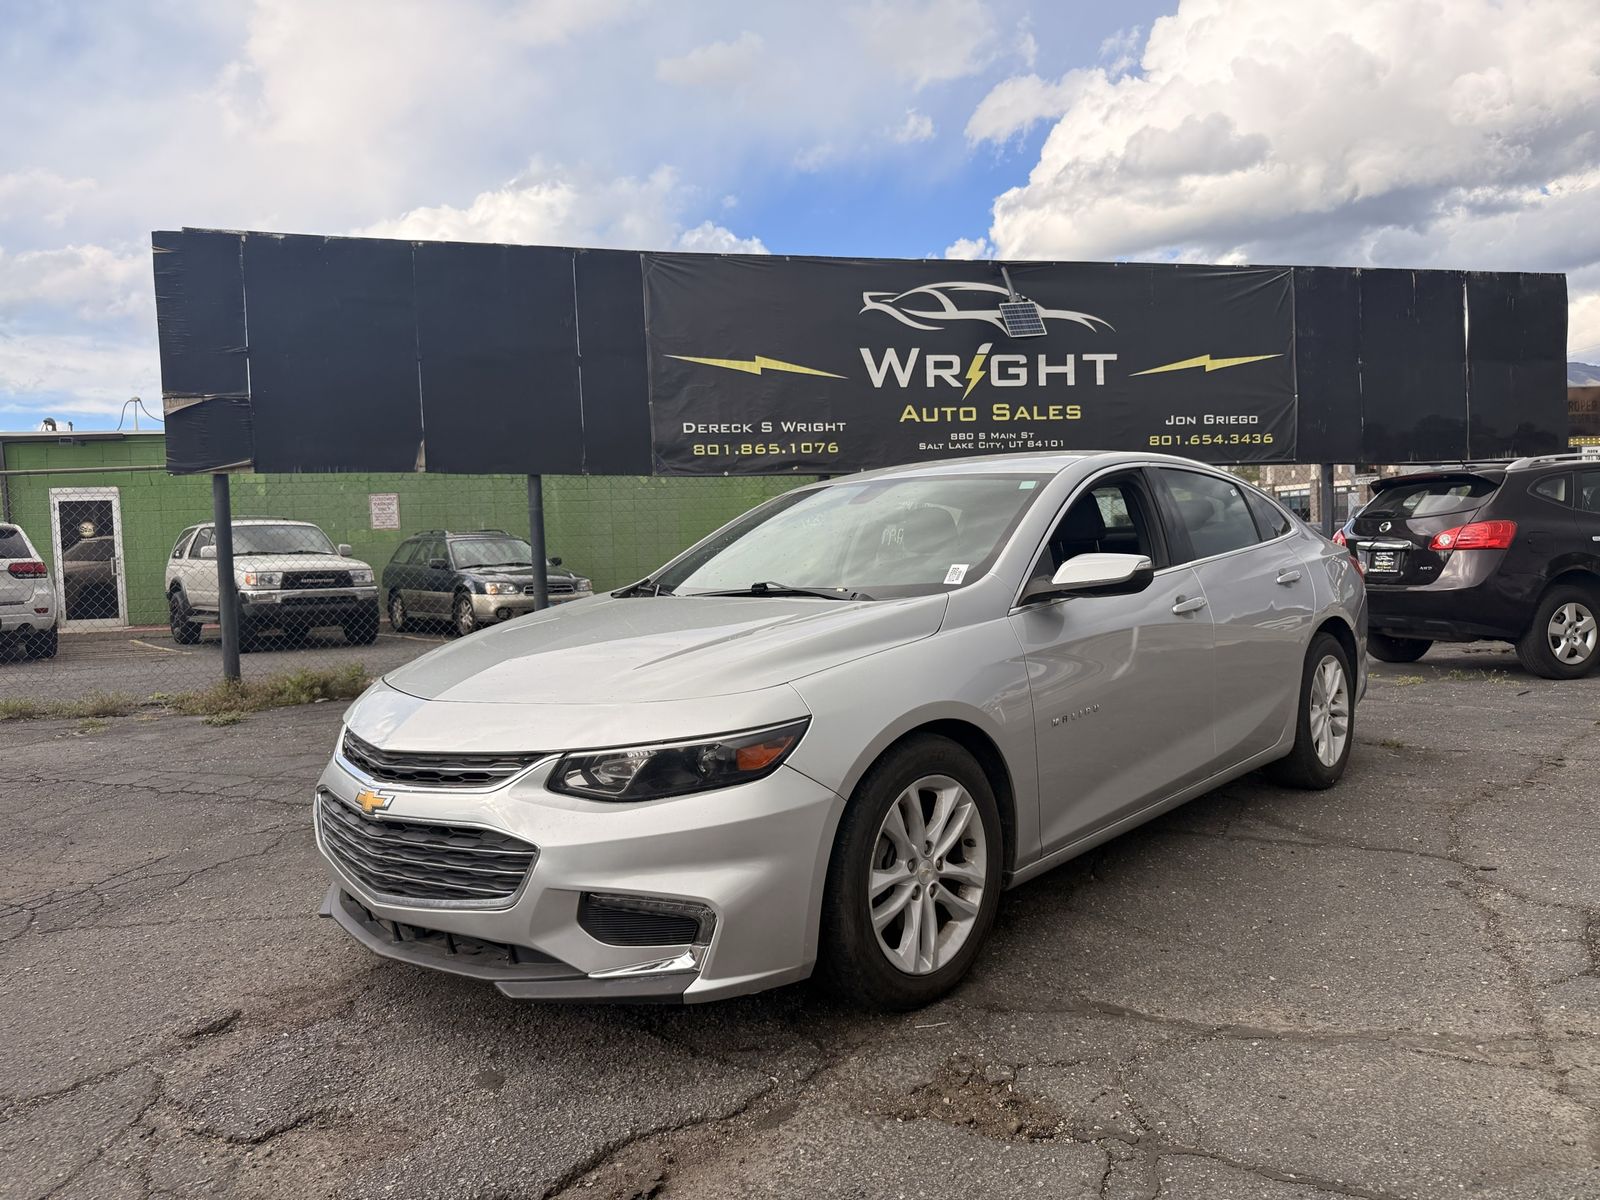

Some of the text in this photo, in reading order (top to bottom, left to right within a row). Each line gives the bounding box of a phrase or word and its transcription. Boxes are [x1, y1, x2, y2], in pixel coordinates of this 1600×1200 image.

[899, 403, 1082, 423] AUTO SALES
[1165, 414, 1259, 426] JON GRIEGO
[682, 421, 847, 434] DERECK S WRIGHT
[950, 432, 974, 441] 880
[978, 432, 986, 440] S
[1149, 433, 1274, 446] 801.654.3436
[693, 442, 839, 456] 801.865.1076
[1008, 440, 1024, 449] UT
[1027, 439, 1065, 448] 84101
